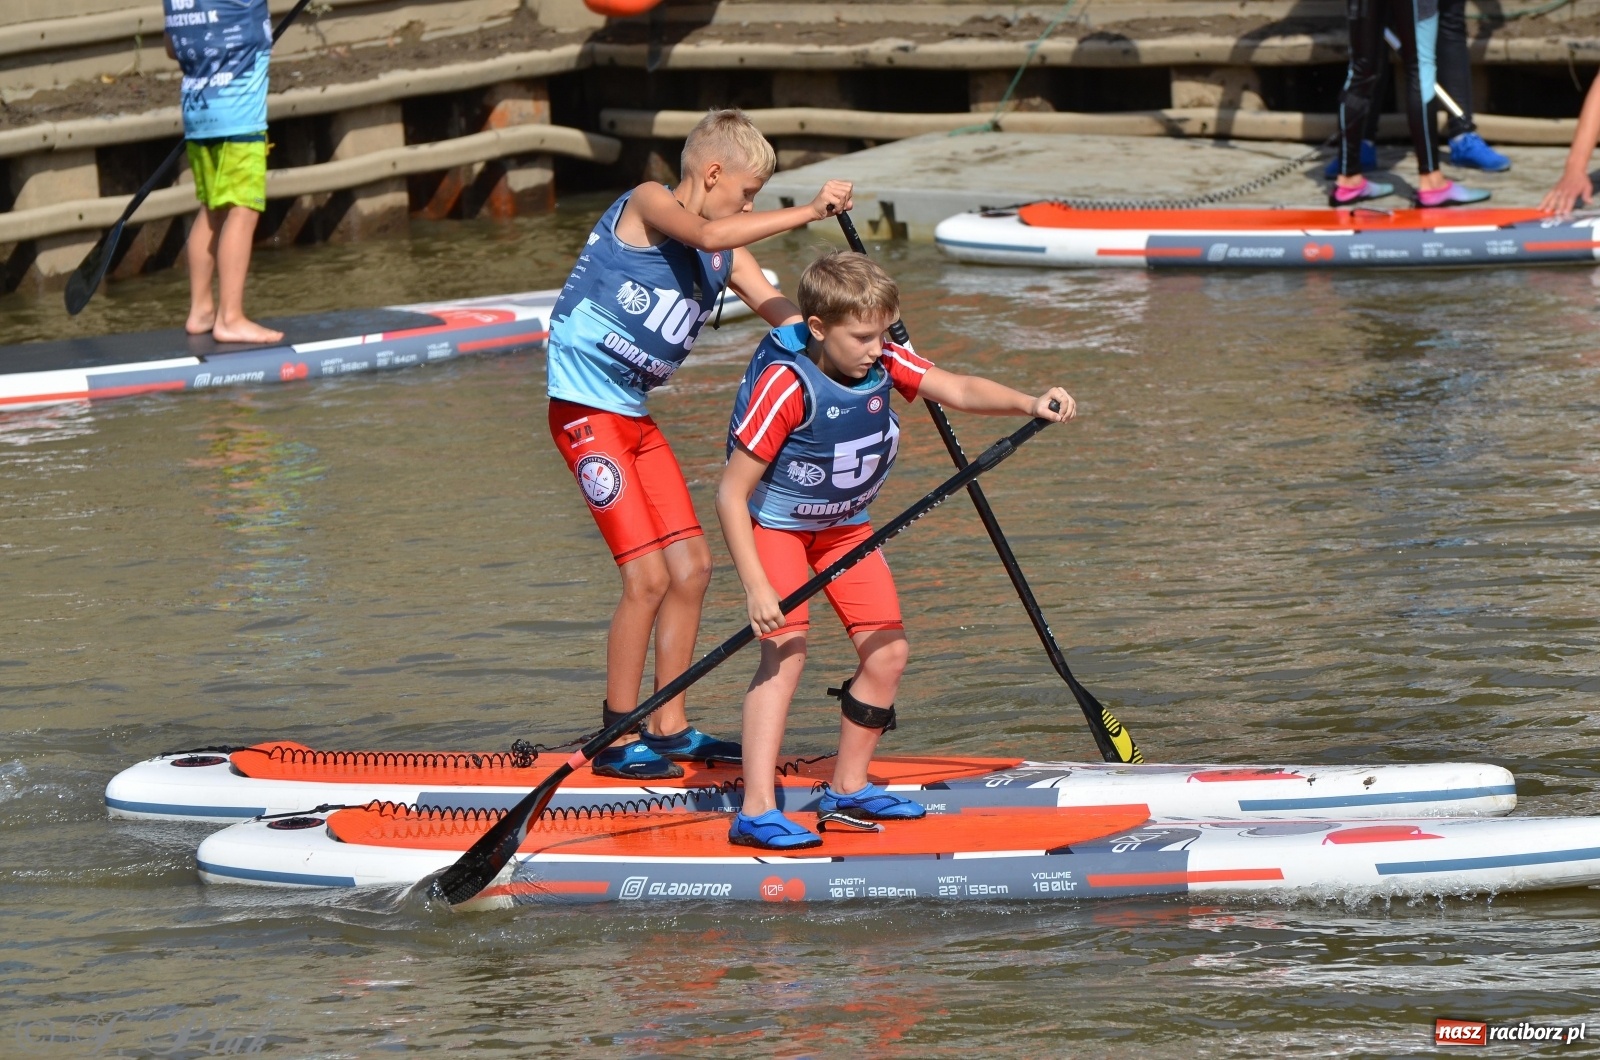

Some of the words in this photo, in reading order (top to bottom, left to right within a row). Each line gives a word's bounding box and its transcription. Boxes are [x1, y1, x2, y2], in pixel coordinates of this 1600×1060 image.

[937, 875, 968, 884] WIDTH
[1031, 871, 1072, 880] VOLUME
[828, 878, 866, 886] LENGTH
[648, 882, 733, 897] GLADIATOR
[868, 886, 917, 897] 320cm
[969, 883, 1009, 895] 59cm
